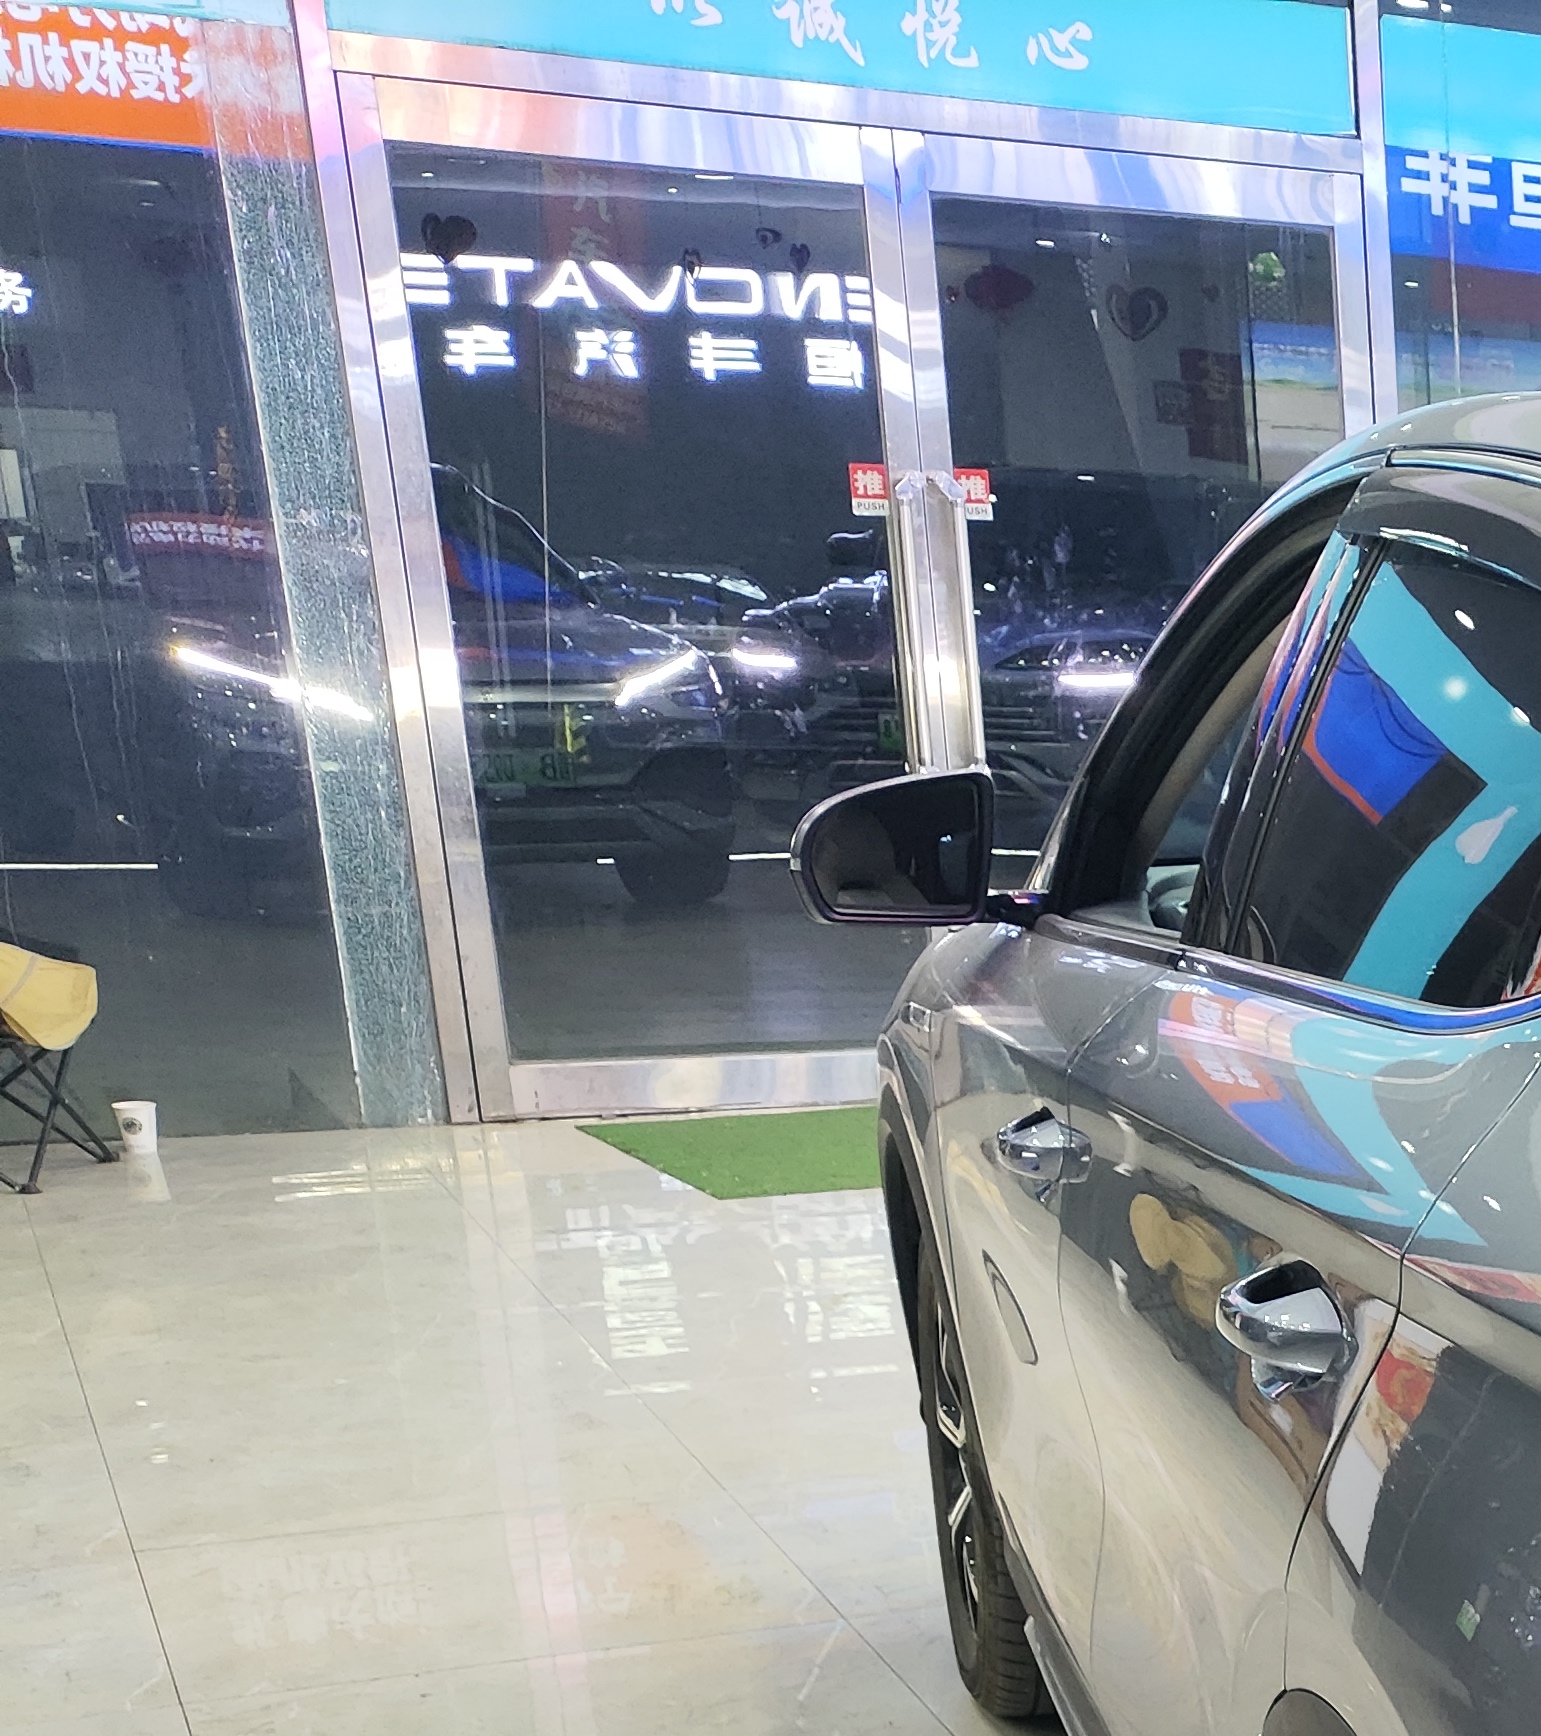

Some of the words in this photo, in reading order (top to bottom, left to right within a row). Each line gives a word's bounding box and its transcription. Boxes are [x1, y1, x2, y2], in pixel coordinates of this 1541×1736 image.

[853, 469, 885, 496] 推
[857, 501, 886, 512] PUSH
[966, 507, 988, 516] USH
